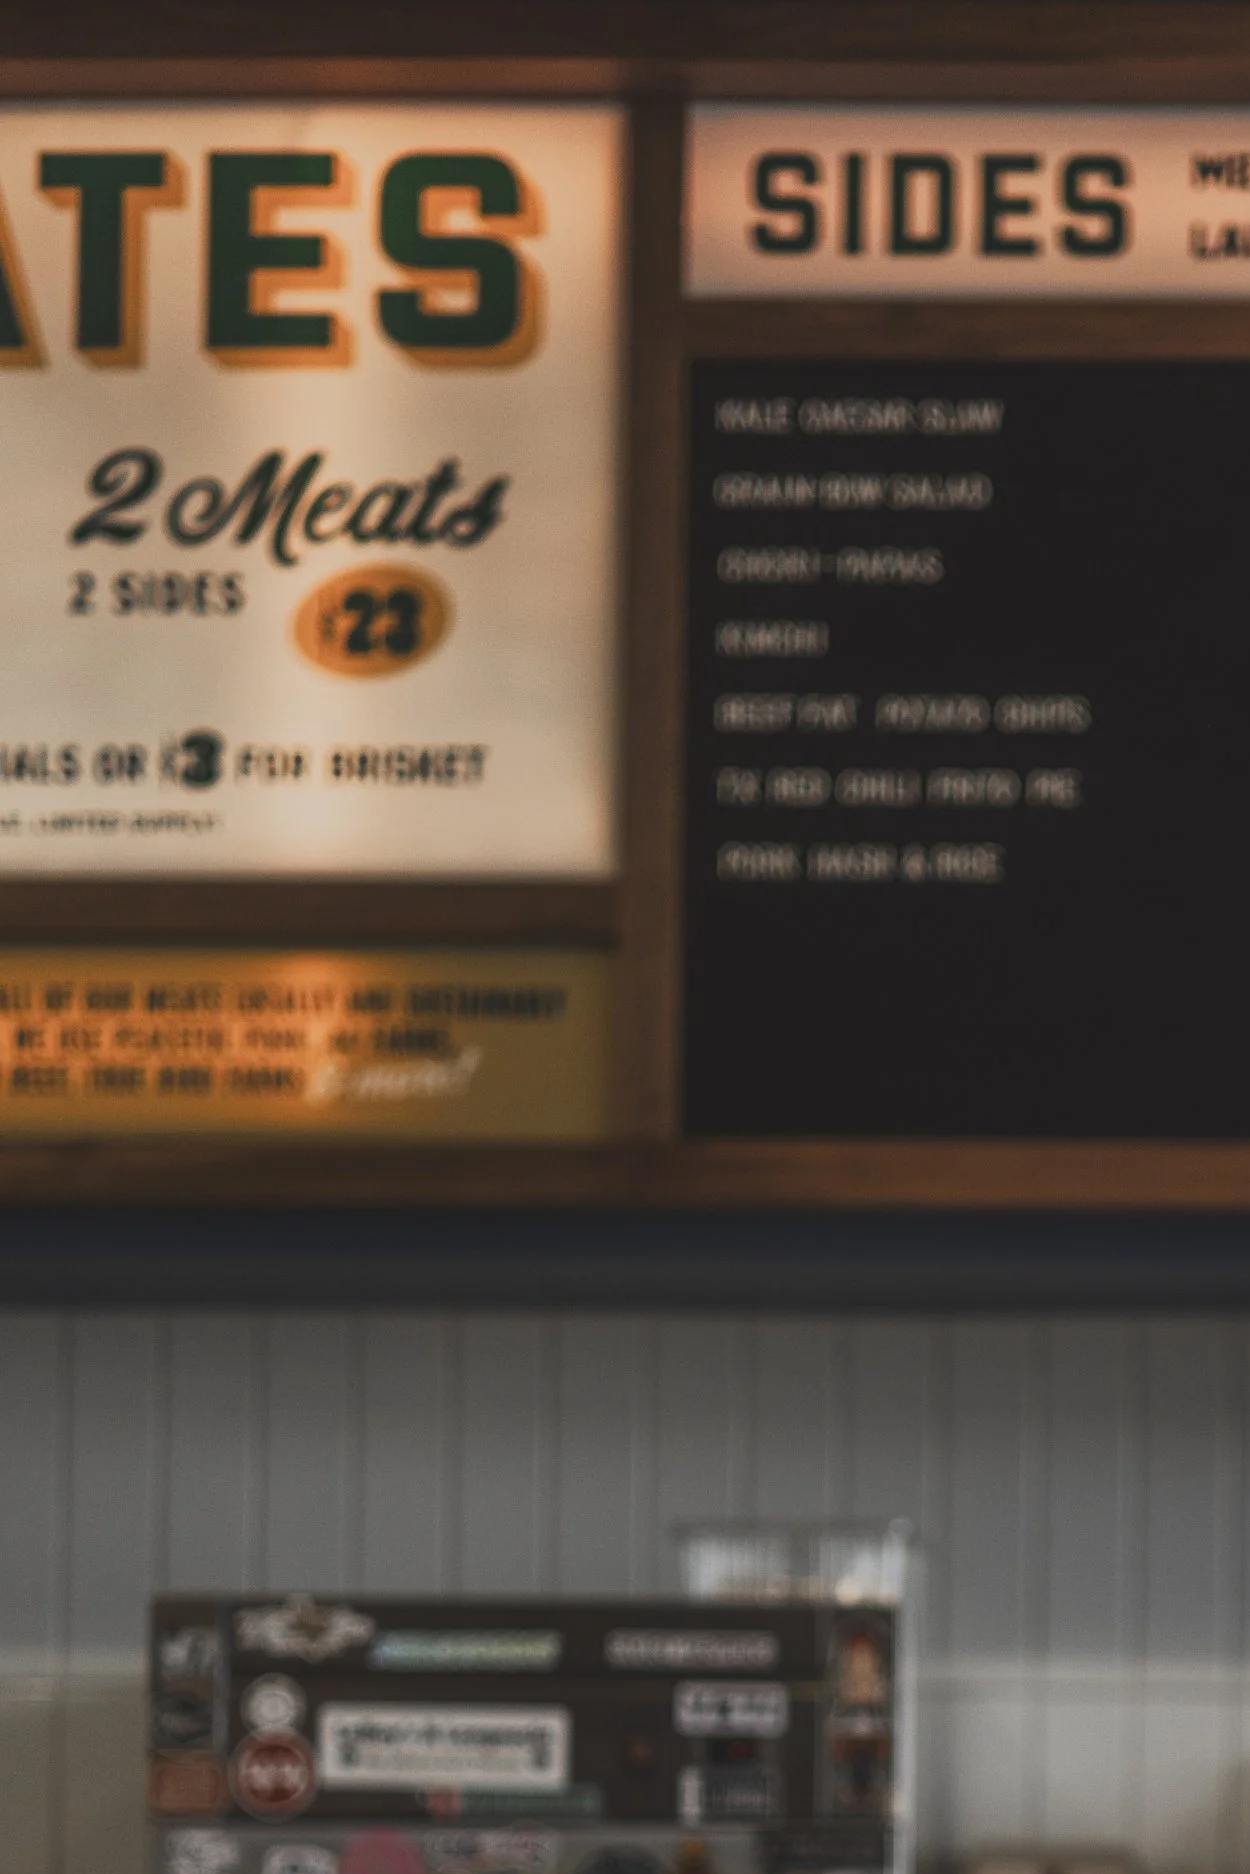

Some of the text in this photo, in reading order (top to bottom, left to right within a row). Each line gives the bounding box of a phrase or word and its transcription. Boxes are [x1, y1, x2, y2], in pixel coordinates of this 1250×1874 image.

[0, 149, 548, 370] TES
[750, 149, 1131, 259] SIDES
[67, 447, 511, 568] 2 Meats
[67, 569, 245, 618] 2 SIDES
